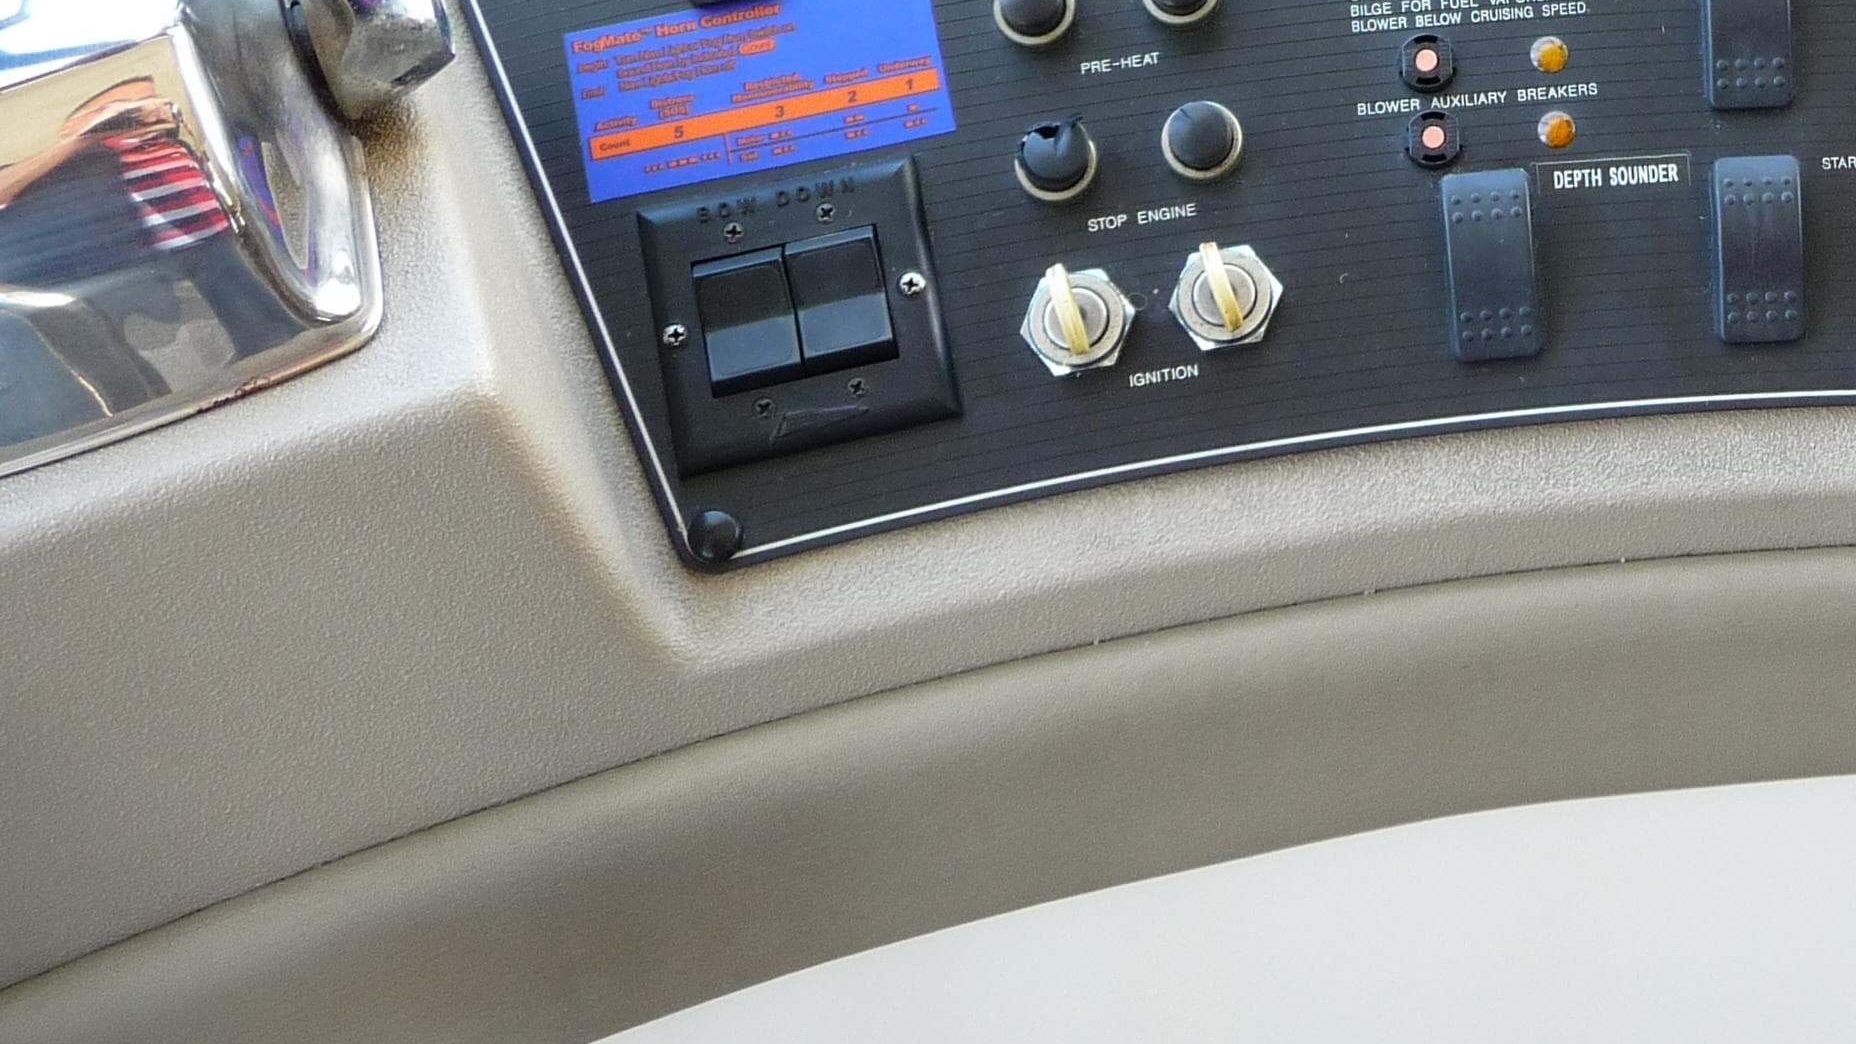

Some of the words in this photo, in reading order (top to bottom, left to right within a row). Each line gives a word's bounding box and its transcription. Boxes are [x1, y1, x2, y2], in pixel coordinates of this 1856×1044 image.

[655, 20, 696, 38] Horn
[700, 3, 781, 29] Controller
[1350, 2, 1392, 18] BILGE
[1402, 0, 1431, 13] FOR
[1351, 16, 1407, 34] BLOWER
[1415, 11, 1462, 28] BELOW
[1471, 7, 1534, 24] CRUISING
[1080, 52, 1159, 75] PRE-HEAT
[673, 125, 684, 140] 5
[774, 105, 785, 119] 3
[847, 90, 858, 104] 2
[906, 77, 914, 90] 1
[1357, 98, 1420, 116] BLOWER
[1430, 91, 1507, 110] AUXILIARY
[1517, 82, 1599, 102] BREAKERS
[1553, 167, 1602, 190] DEPTH
[1609, 163, 1679, 187] SOUNDER
[1087, 214, 1127, 232] STOP
[1137, 203, 1197, 226] ENGINE
[1129, 364, 1199, 388] IGNITION
